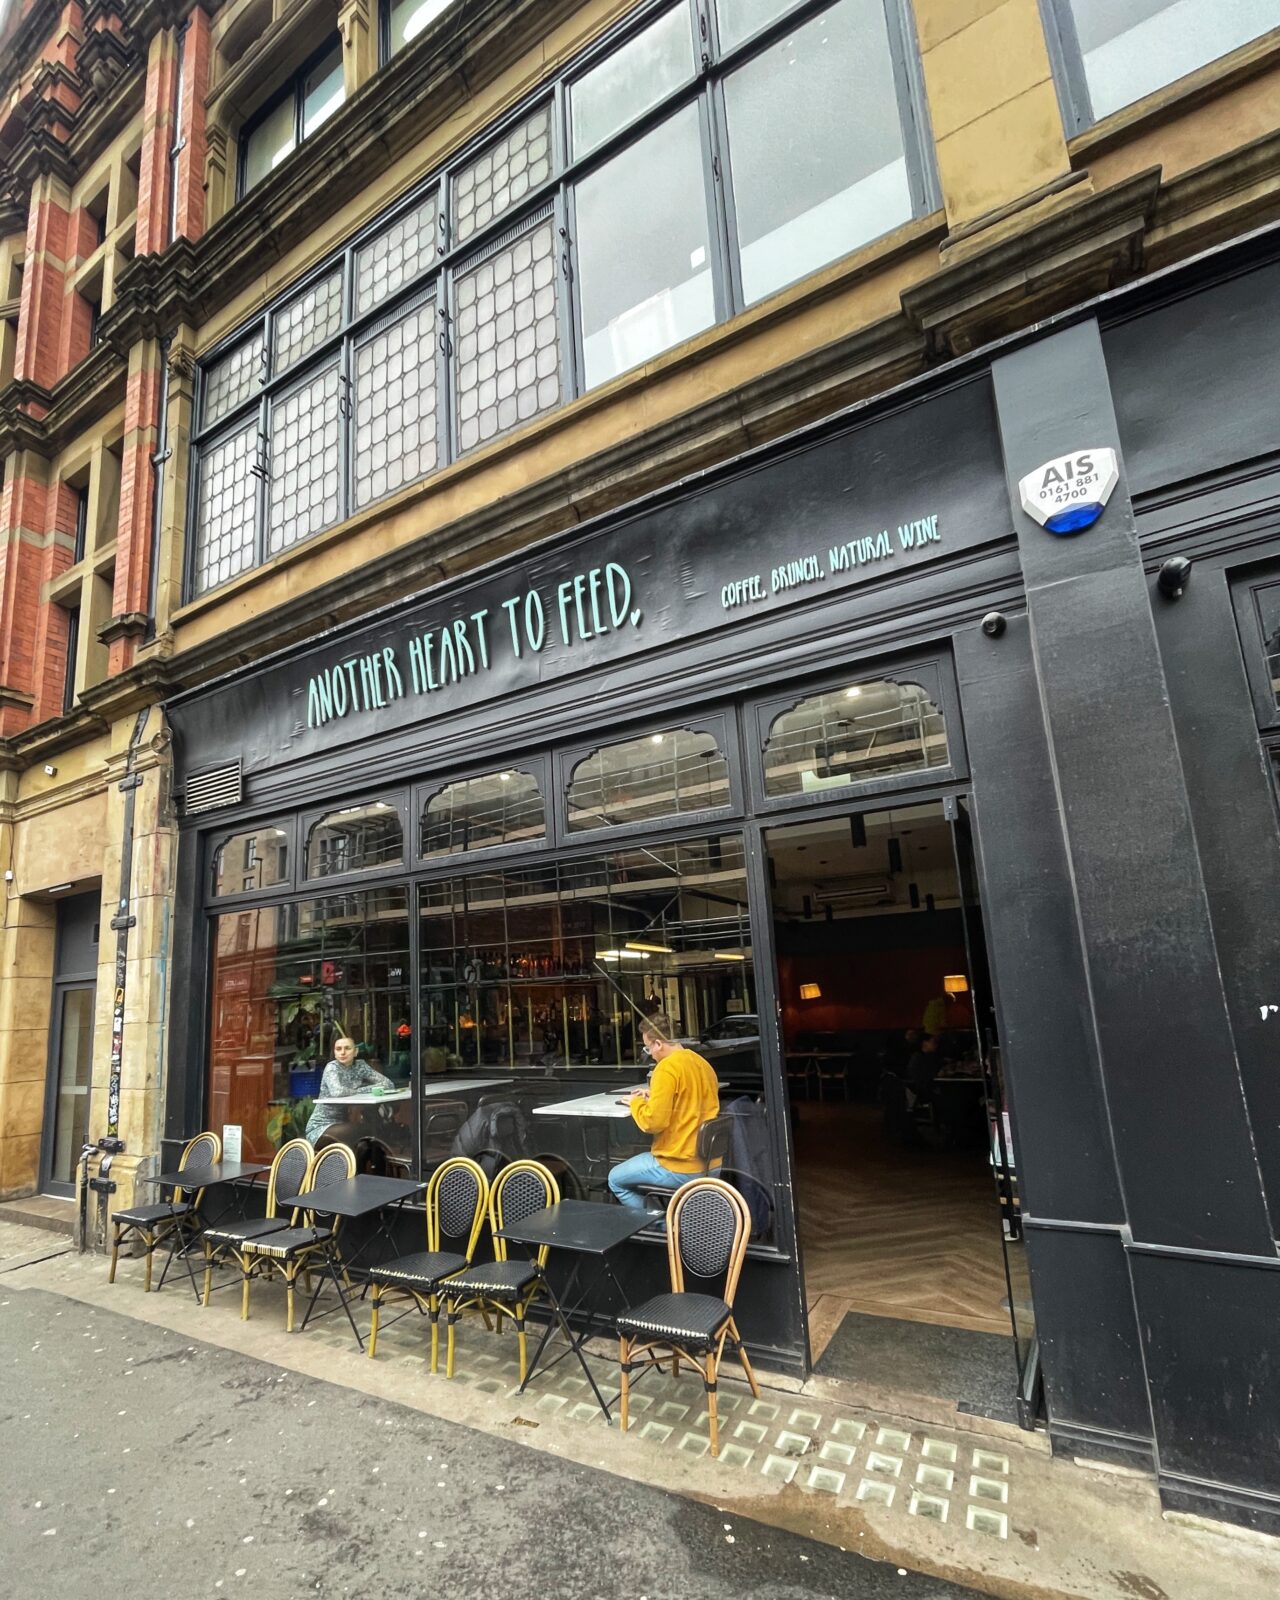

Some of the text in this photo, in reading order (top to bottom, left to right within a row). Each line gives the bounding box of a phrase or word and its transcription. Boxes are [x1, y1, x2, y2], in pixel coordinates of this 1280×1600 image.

[1039, 473, 1099, 499] 0161 881
[1042, 455, 1094, 489] AIS
[1055, 487, 1087, 504] 4700
[829, 530, 893, 572] NATURAL
[898, 514, 941, 549] WINE
[307, 647, 402, 728] ANOTHER
[408, 609, 489, 694] HEART
[502, 590, 544, 657] TO
